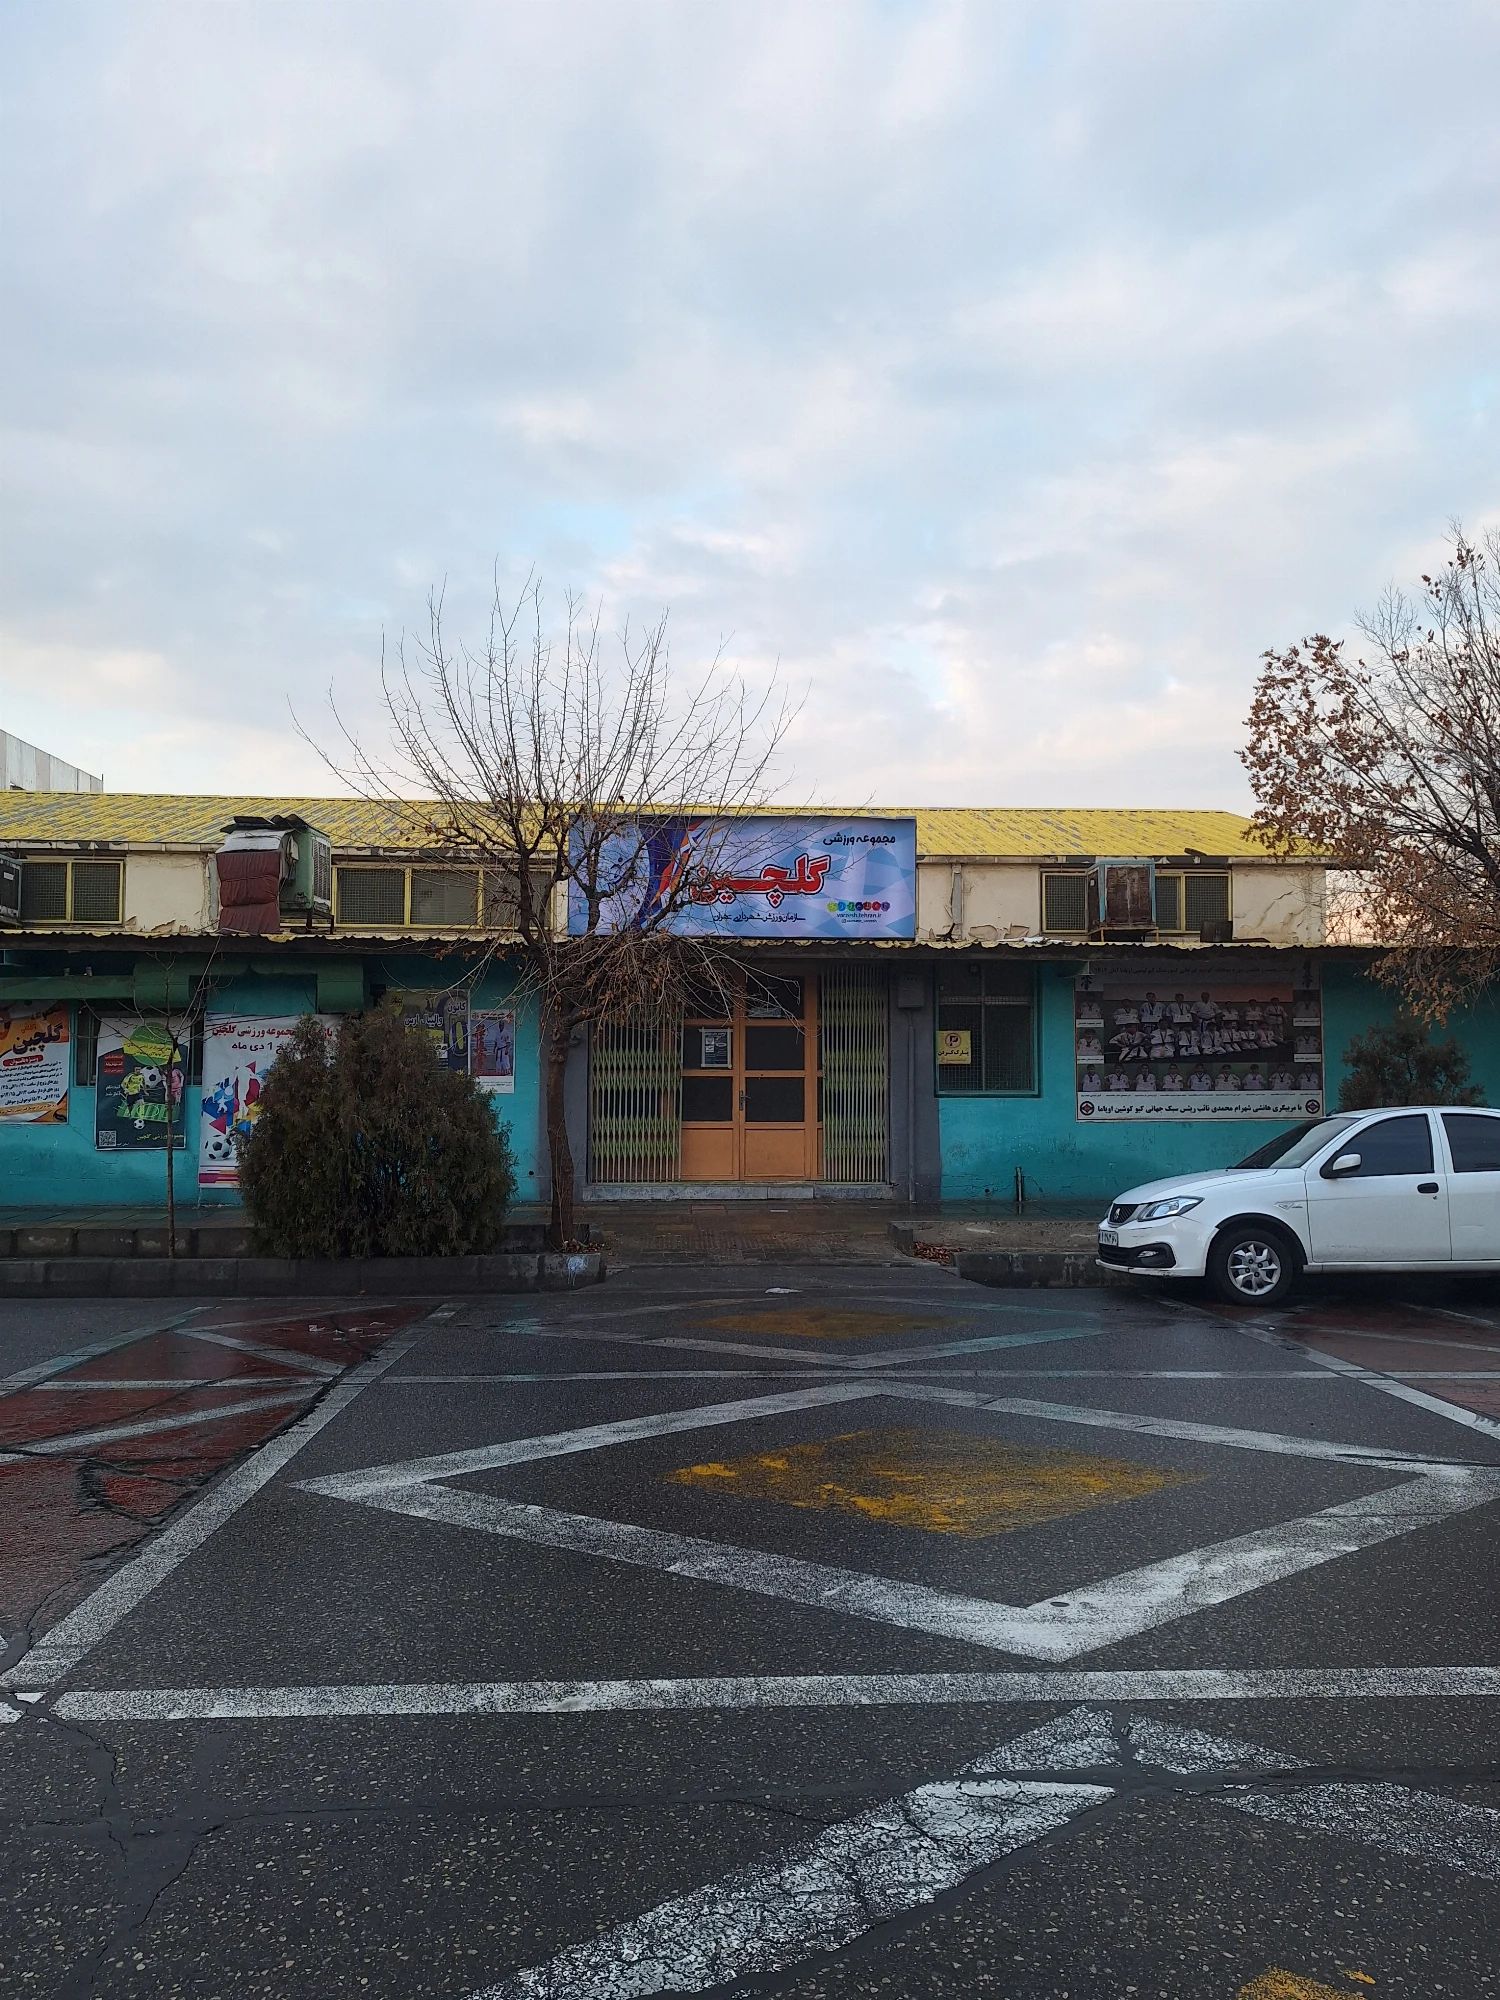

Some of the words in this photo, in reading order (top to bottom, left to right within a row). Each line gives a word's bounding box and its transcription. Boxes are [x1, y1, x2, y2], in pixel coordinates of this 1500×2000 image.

[823, 832, 856, 846] ورزشی
[856, 833, 896, 846] مجموعه
[689, 853, 831, 908] گلچین
[448, 1001, 466, 1013] کانون
[212, 1024, 237, 1037] گلچین
[237, 1026, 266, 1038] ورزشی
[13, 1022, 63, 1054] گلچین
[231, 1042, 247, 1050] ماه
[249, 1044, 265, 1052] دی
[267, 1042, 273, 1050] 1
[1097, 1105, 1114, 1113] اویاما
[1114, 1105, 1133, 1113] کوشین
[1145, 1105, 1164, 1113] جهانی
[1211, 1105, 1233, 1113] محمدی
[1234, 1104, 1252, 1113] شهرام
[1272, 1104, 1297, 1113] مربیگری
[1297, 1104, 1302, 1112] با
